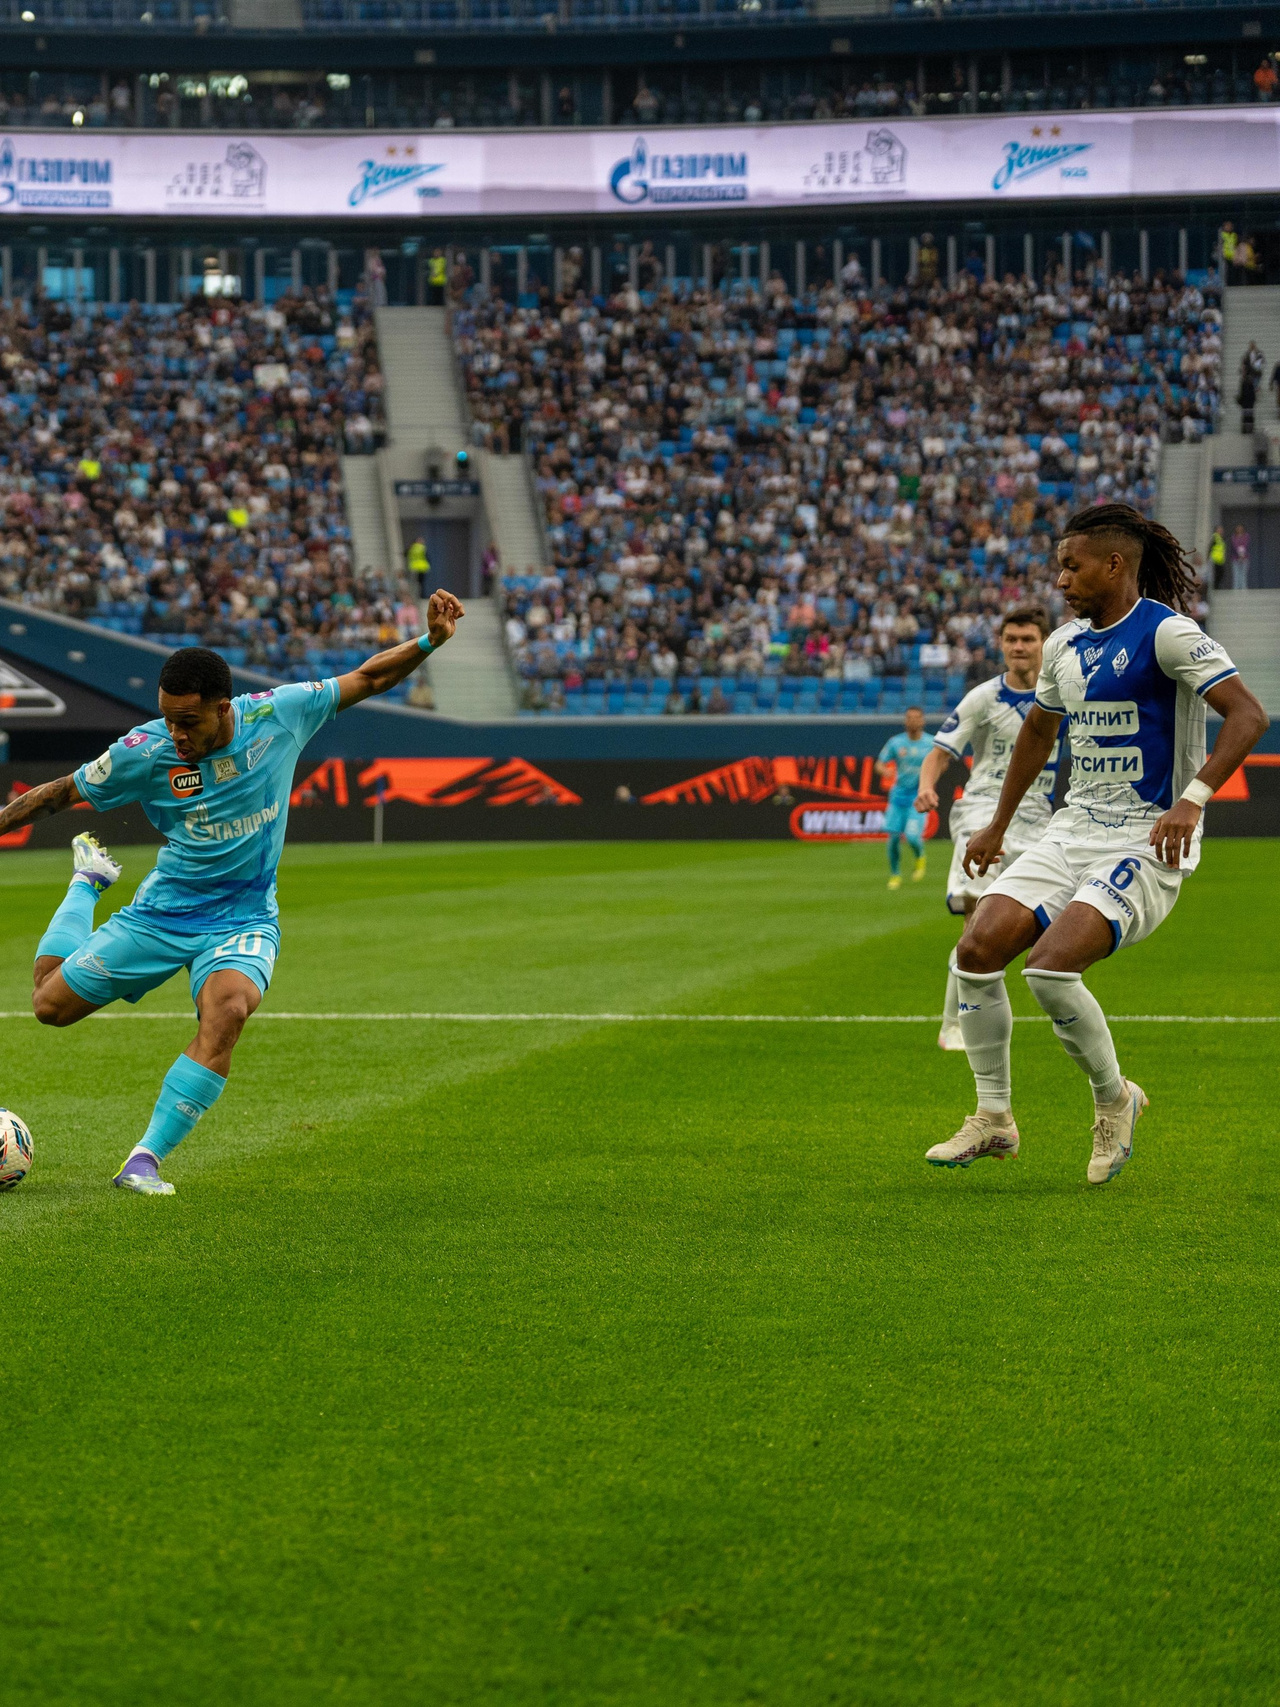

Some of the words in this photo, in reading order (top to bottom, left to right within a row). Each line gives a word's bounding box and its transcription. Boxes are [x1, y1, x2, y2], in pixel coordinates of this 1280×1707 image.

[19, 158, 112, 183] ГАЗПРОМ
[651, 152, 747, 179] ГАЗПРОМ
[1068, 710, 1135, 726] МАГНИТ
[177, 774, 200, 788] WIN
[214, 800, 279, 841] ГАЗПРОМ
[1109, 857, 1142, 891] 6
[213, 931, 262, 958] 20
